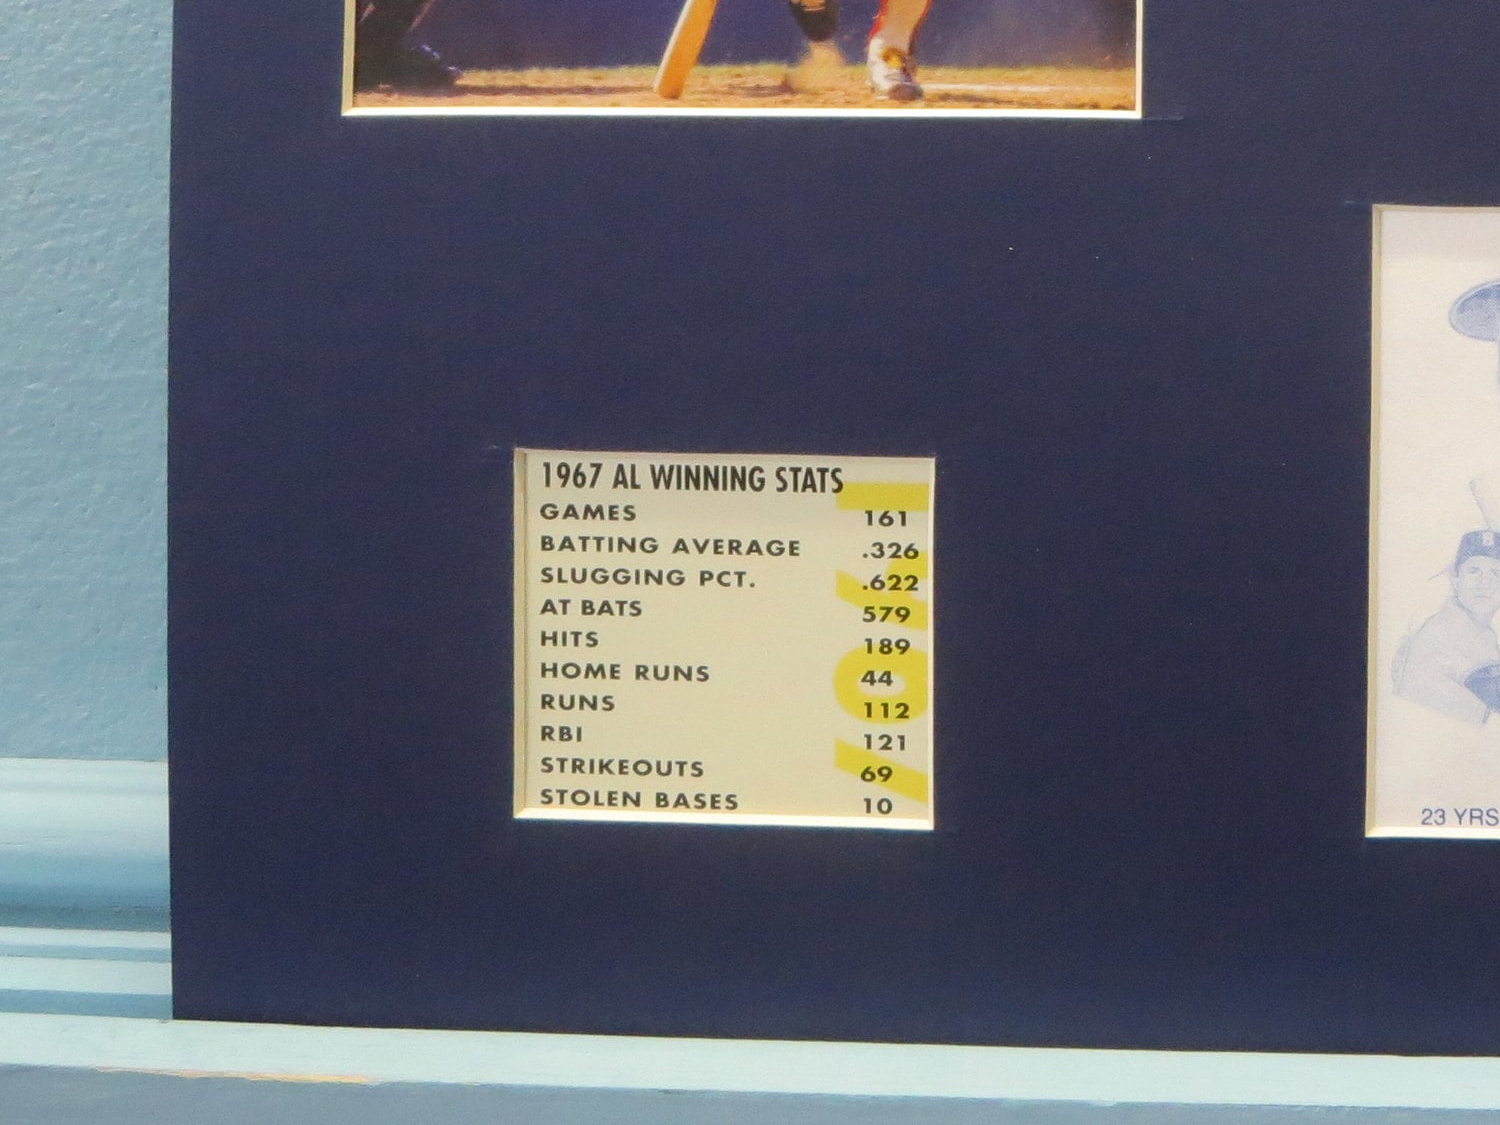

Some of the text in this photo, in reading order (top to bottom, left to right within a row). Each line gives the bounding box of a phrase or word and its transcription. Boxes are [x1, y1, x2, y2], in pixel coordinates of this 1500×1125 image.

[542, 461, 844, 494] 1967 AL WINNING STATS
[539, 502, 907, 527] GAMES 161
[540, 535, 919, 560] BATTING AVERAGE .326
[540, 566, 919, 591] SLUGGING PCT. .622
[539, 598, 910, 623] AT BATS 579
[540, 630, 910, 655] HITS 189
[540, 662, 893, 686] HOME RUNS 44
[540, 693, 910, 719] RUNS 112
[540, 725, 906, 751] RBI 121
[540, 756, 892, 782] STRIKEOUTS 69
[540, 788, 892, 814] STOLEN BASES 10
[1420, 807, 1446, 826] 23
